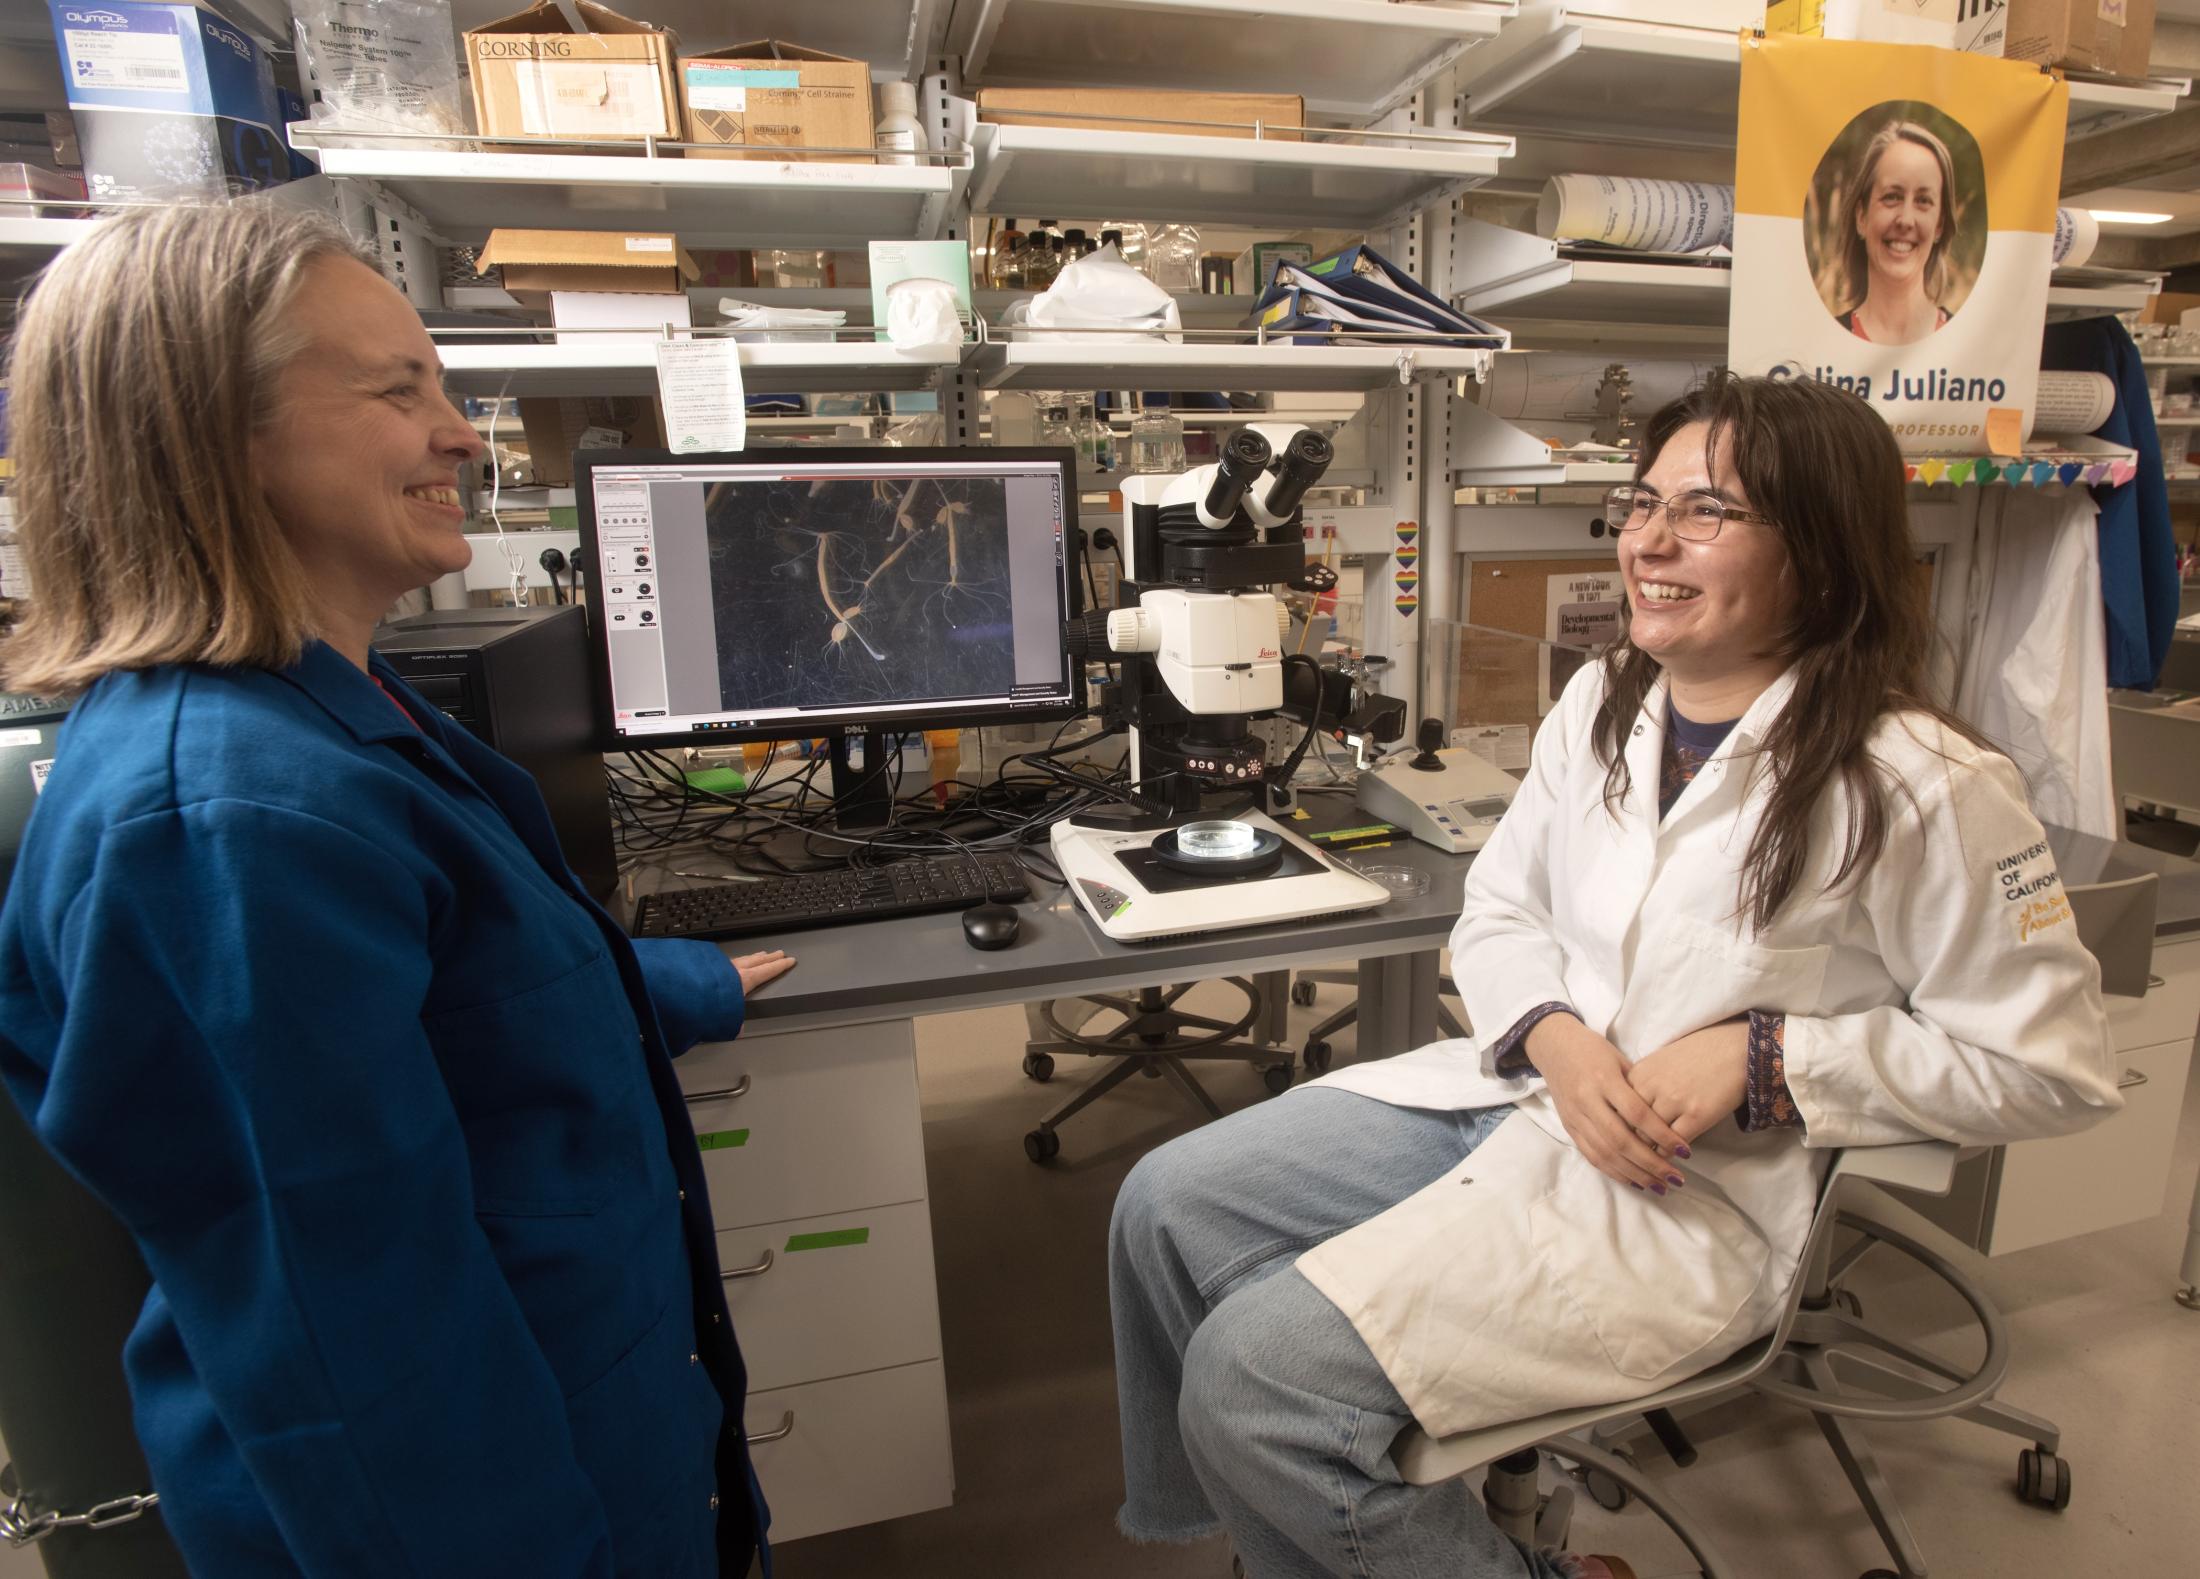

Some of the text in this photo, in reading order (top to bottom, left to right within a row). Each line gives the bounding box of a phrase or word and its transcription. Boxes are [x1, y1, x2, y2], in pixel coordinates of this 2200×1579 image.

[66, 11, 128, 24] Olympus
[329, 21, 379, 38] Thermo
[358, 44, 388, 56] System
[478, 41, 571, 57] CORNING
[807, 90, 822, 98] Cell
[823, 91, 856, 99] Strainer
[1767, 365, 1871, 400] Clina
[1883, 369, 2006, 402] Juliano
[1575, 581, 1591, 592] NEW
[1577, 592, 1585, 603] IN
[1561, 612, 1616, 625] Developmental
[1561, 625, 1590, 635] Biology
[1258, 648, 1278, 659] Leica
[844, 725, 869, 735] DELL
[2001, 870, 2022, 887] OF
